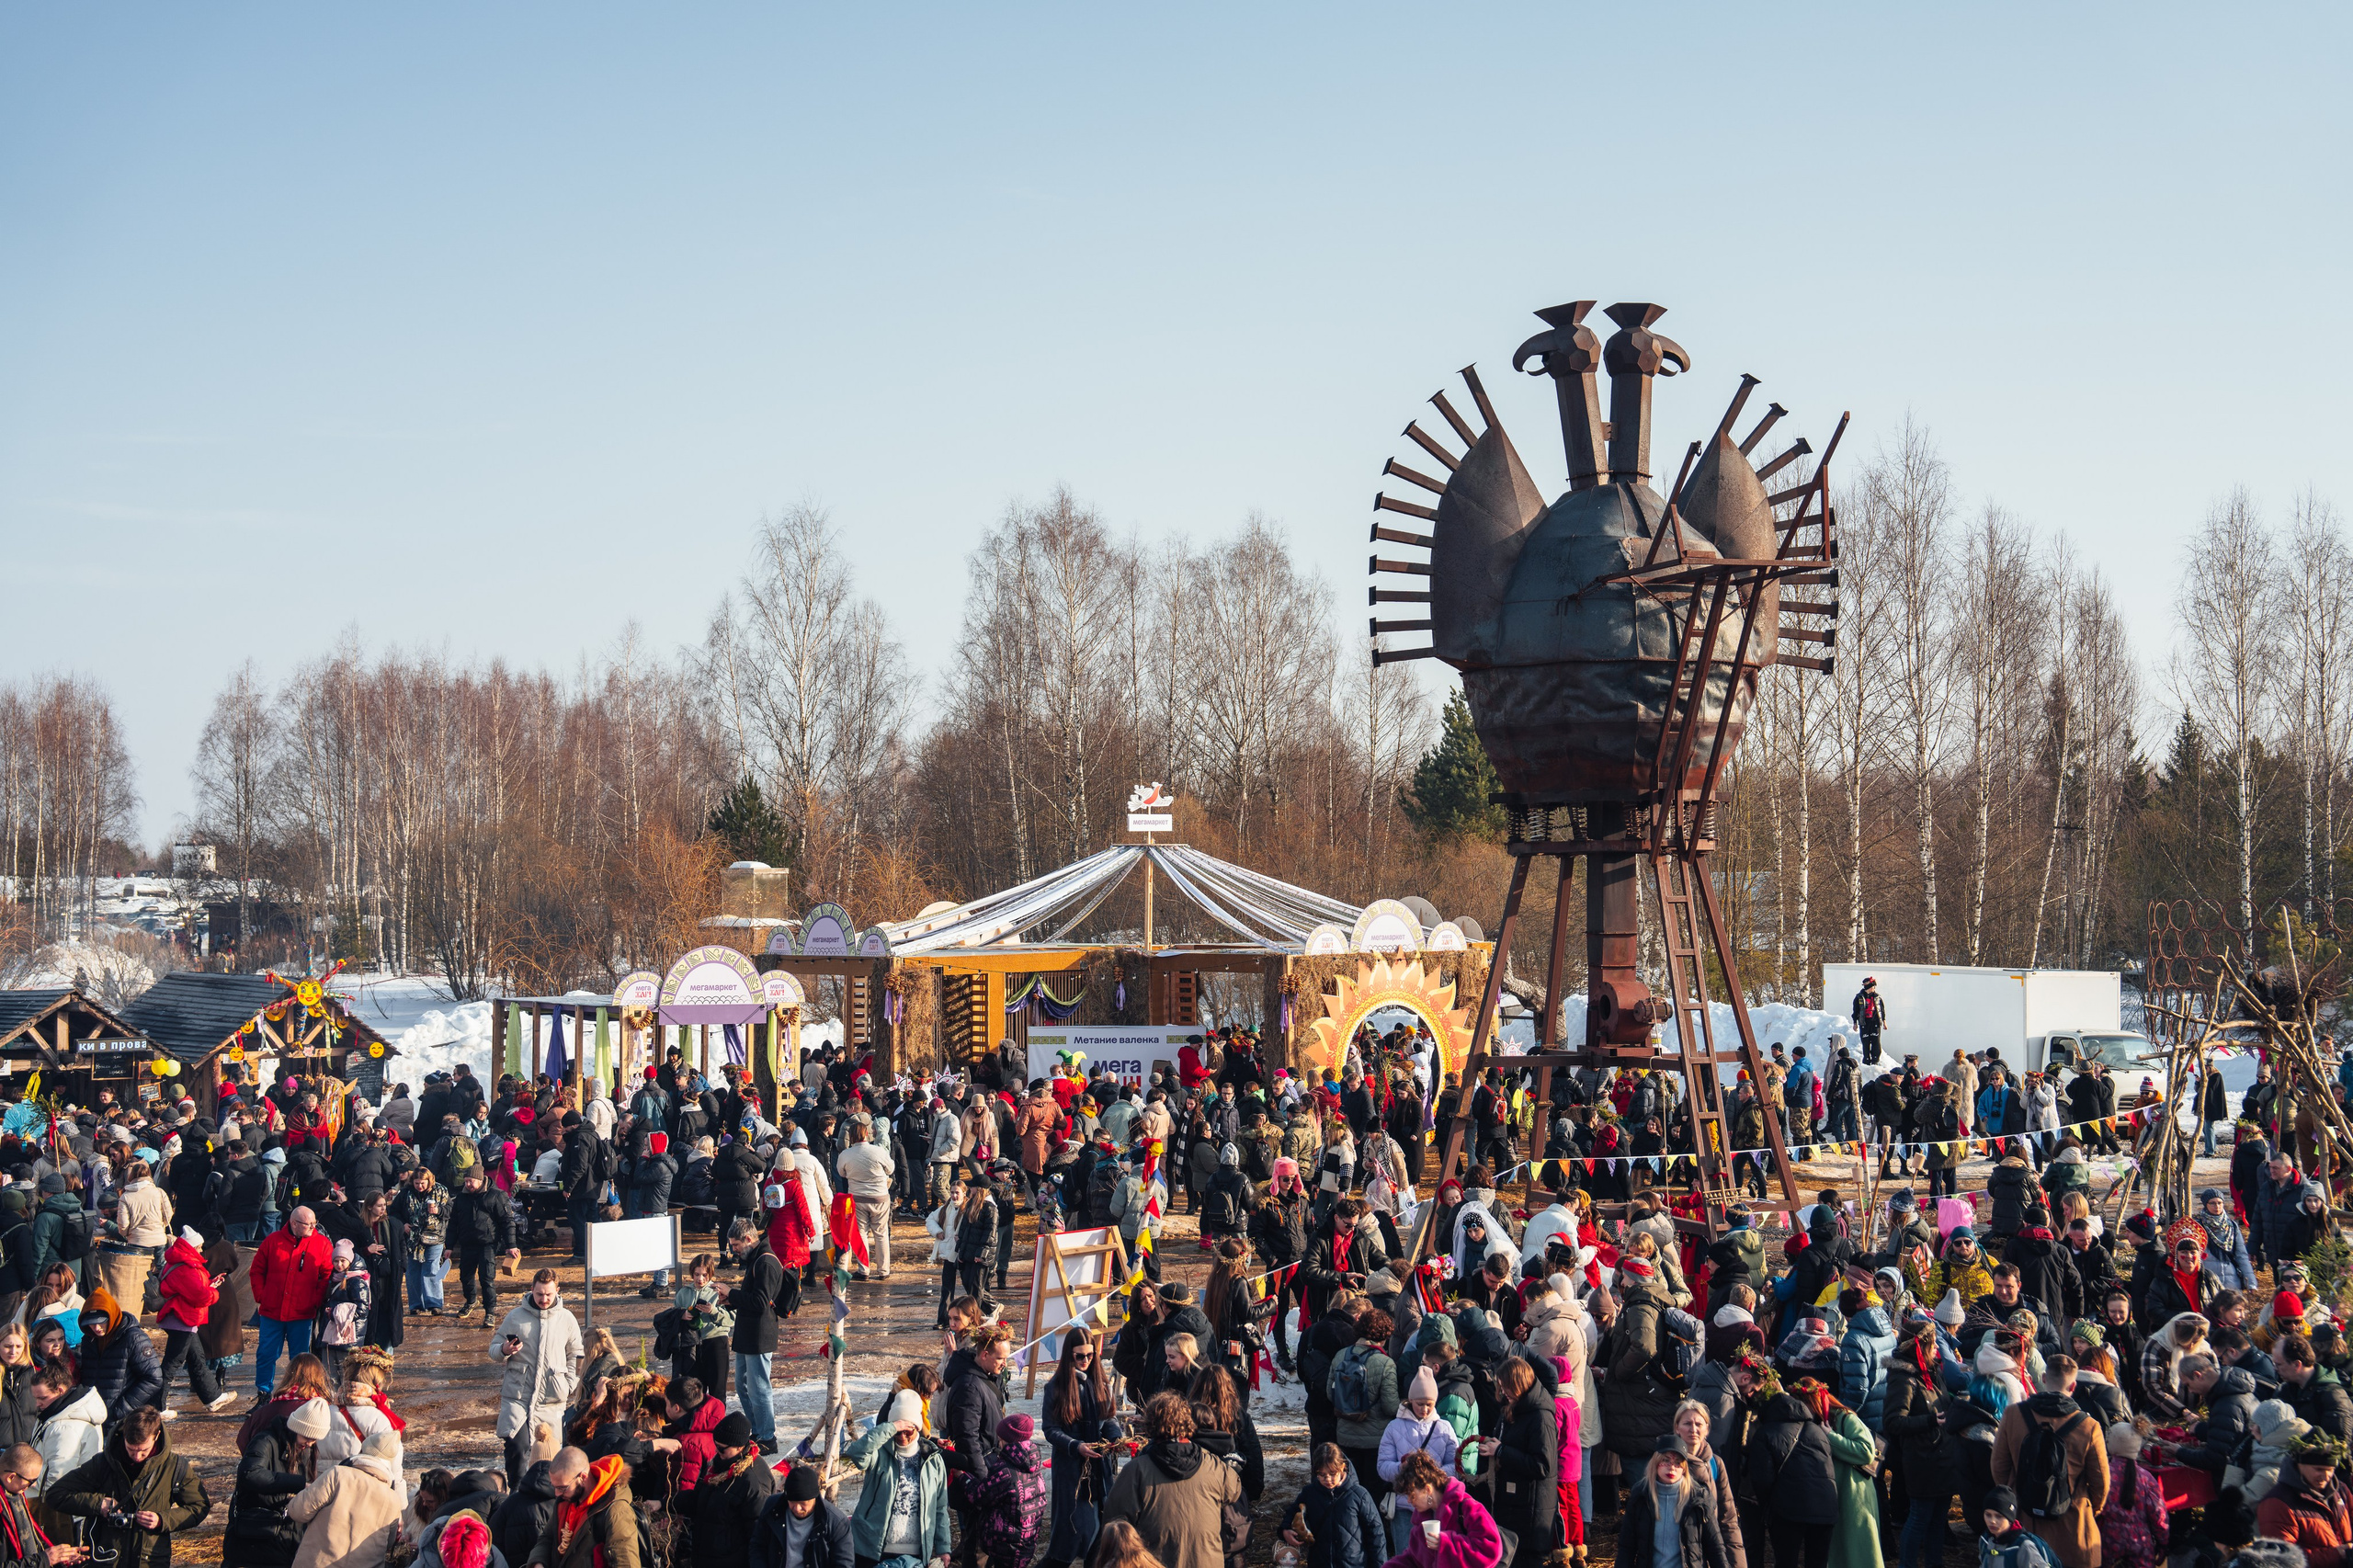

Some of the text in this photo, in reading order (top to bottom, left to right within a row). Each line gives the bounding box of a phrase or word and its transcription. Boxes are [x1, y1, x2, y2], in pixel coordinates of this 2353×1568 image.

[689, 983, 738, 993] мегамаркет
[1074, 1036, 1118, 1044] Метание
[79, 1042, 95, 1051] ки
[99, 1042, 107, 1051] в
[1094, 1060, 1142, 1074] мега
